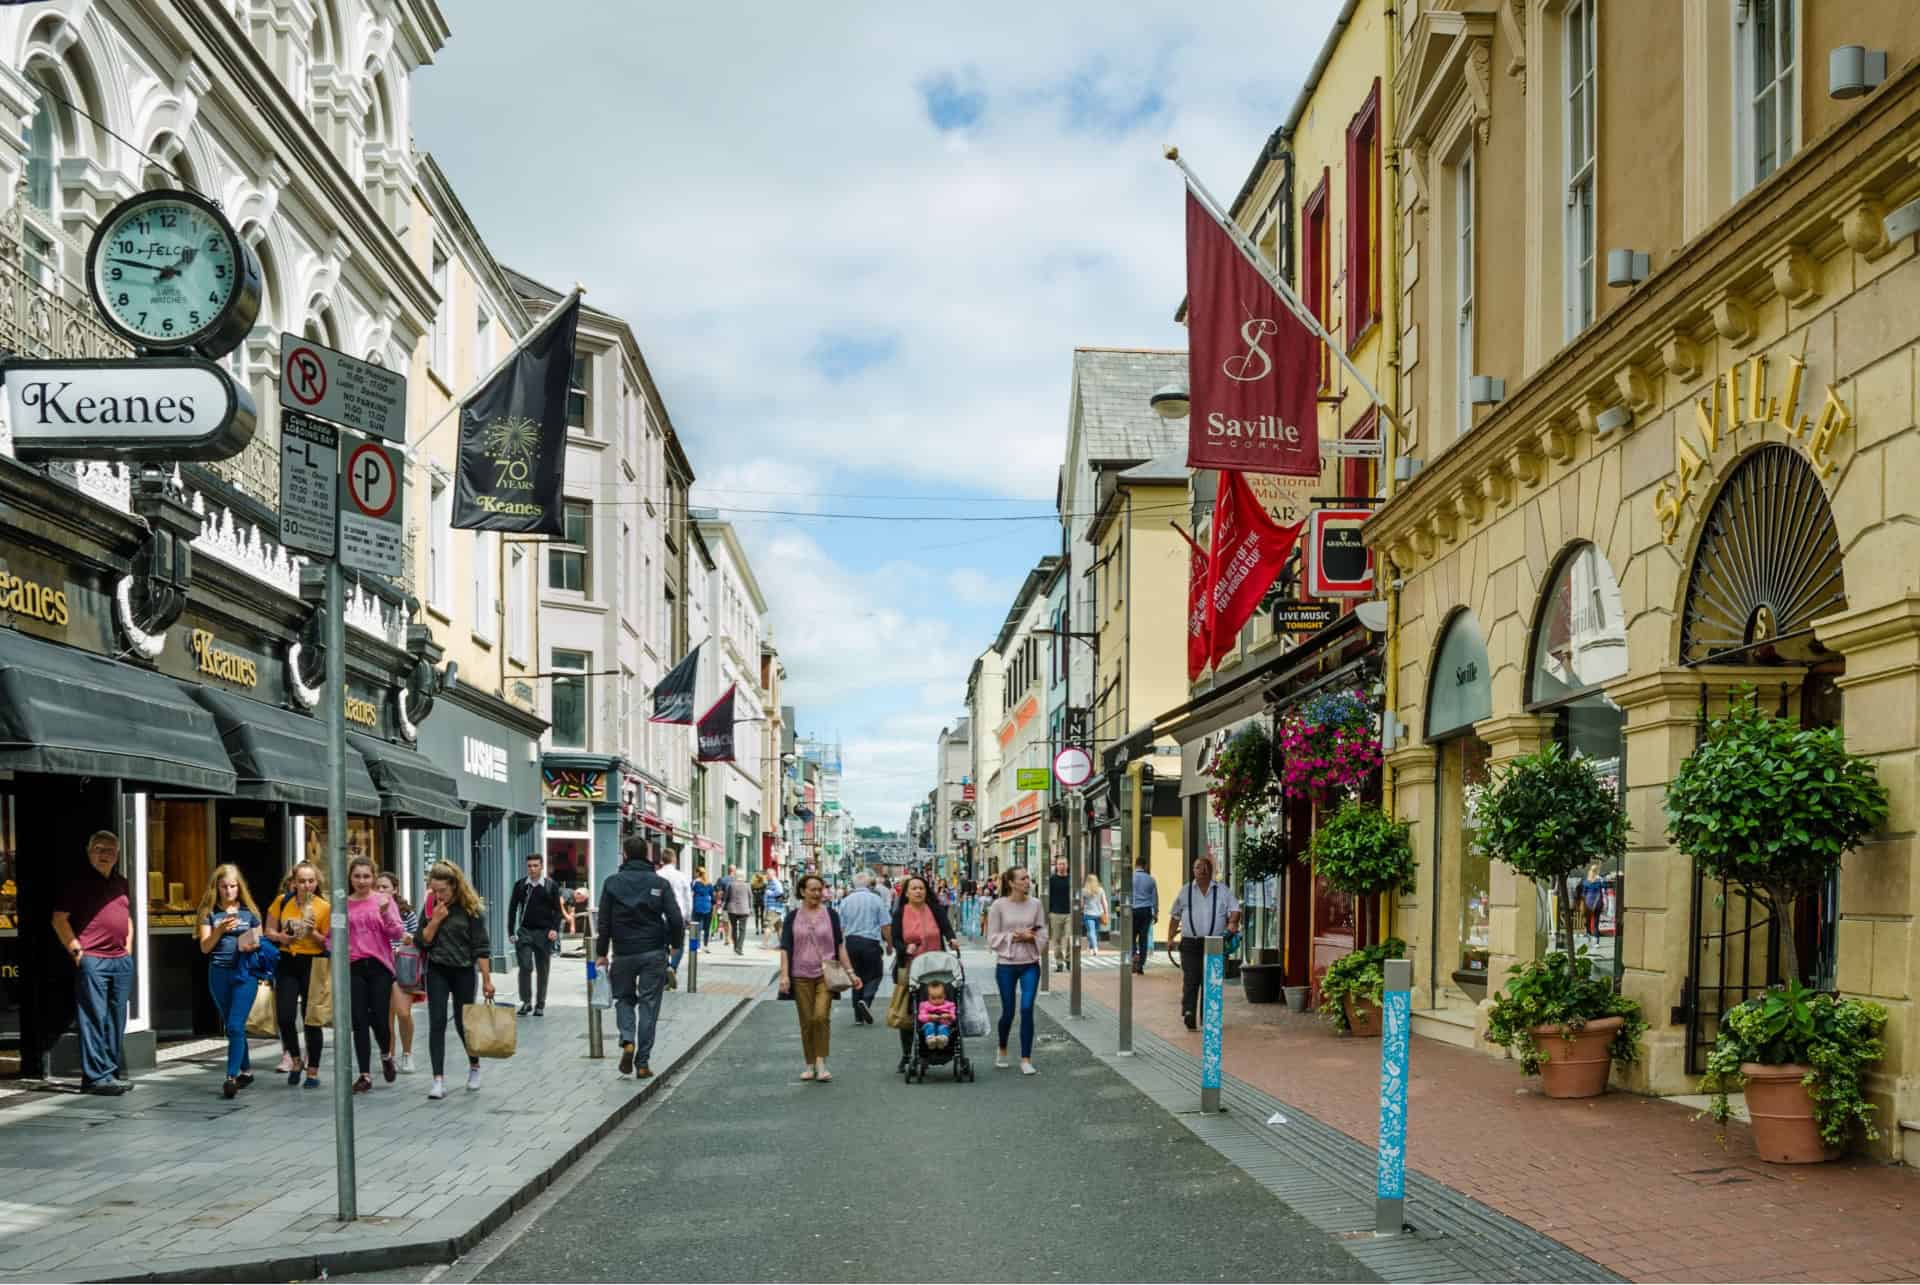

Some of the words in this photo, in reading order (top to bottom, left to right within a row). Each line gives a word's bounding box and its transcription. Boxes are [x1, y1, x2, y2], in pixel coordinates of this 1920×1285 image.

[160, 215, 176, 228] 12
[138, 223, 150, 234] 11
[118, 241, 134, 254] 10
[208, 240, 218, 252] 2
[112, 268, 122, 280] 9
[216, 265, 225, 279] 3
[118, 293, 128, 306] 8
[210, 291, 218, 304] 4
[138, 312, 147, 325] 7
[190, 311, 199, 324] 5
[162, 318, 173, 331] 6
[22, 382, 195, 424] Keanes
[1207, 412, 1300, 442] Saville
[1655, 354, 1851, 546] SAVILLE
[495, 459, 528, 488] 70
[502, 479, 535, 490] YEARS
[474, 496, 543, 516] Keanes
[1264, 506, 1296, 520] AR
[283, 519, 298, 534] 30
[1280, 612, 1298, 620] LIVE
[1300, 612, 1330, 620] MUSIC
[193, 628, 256, 687] Keanes
